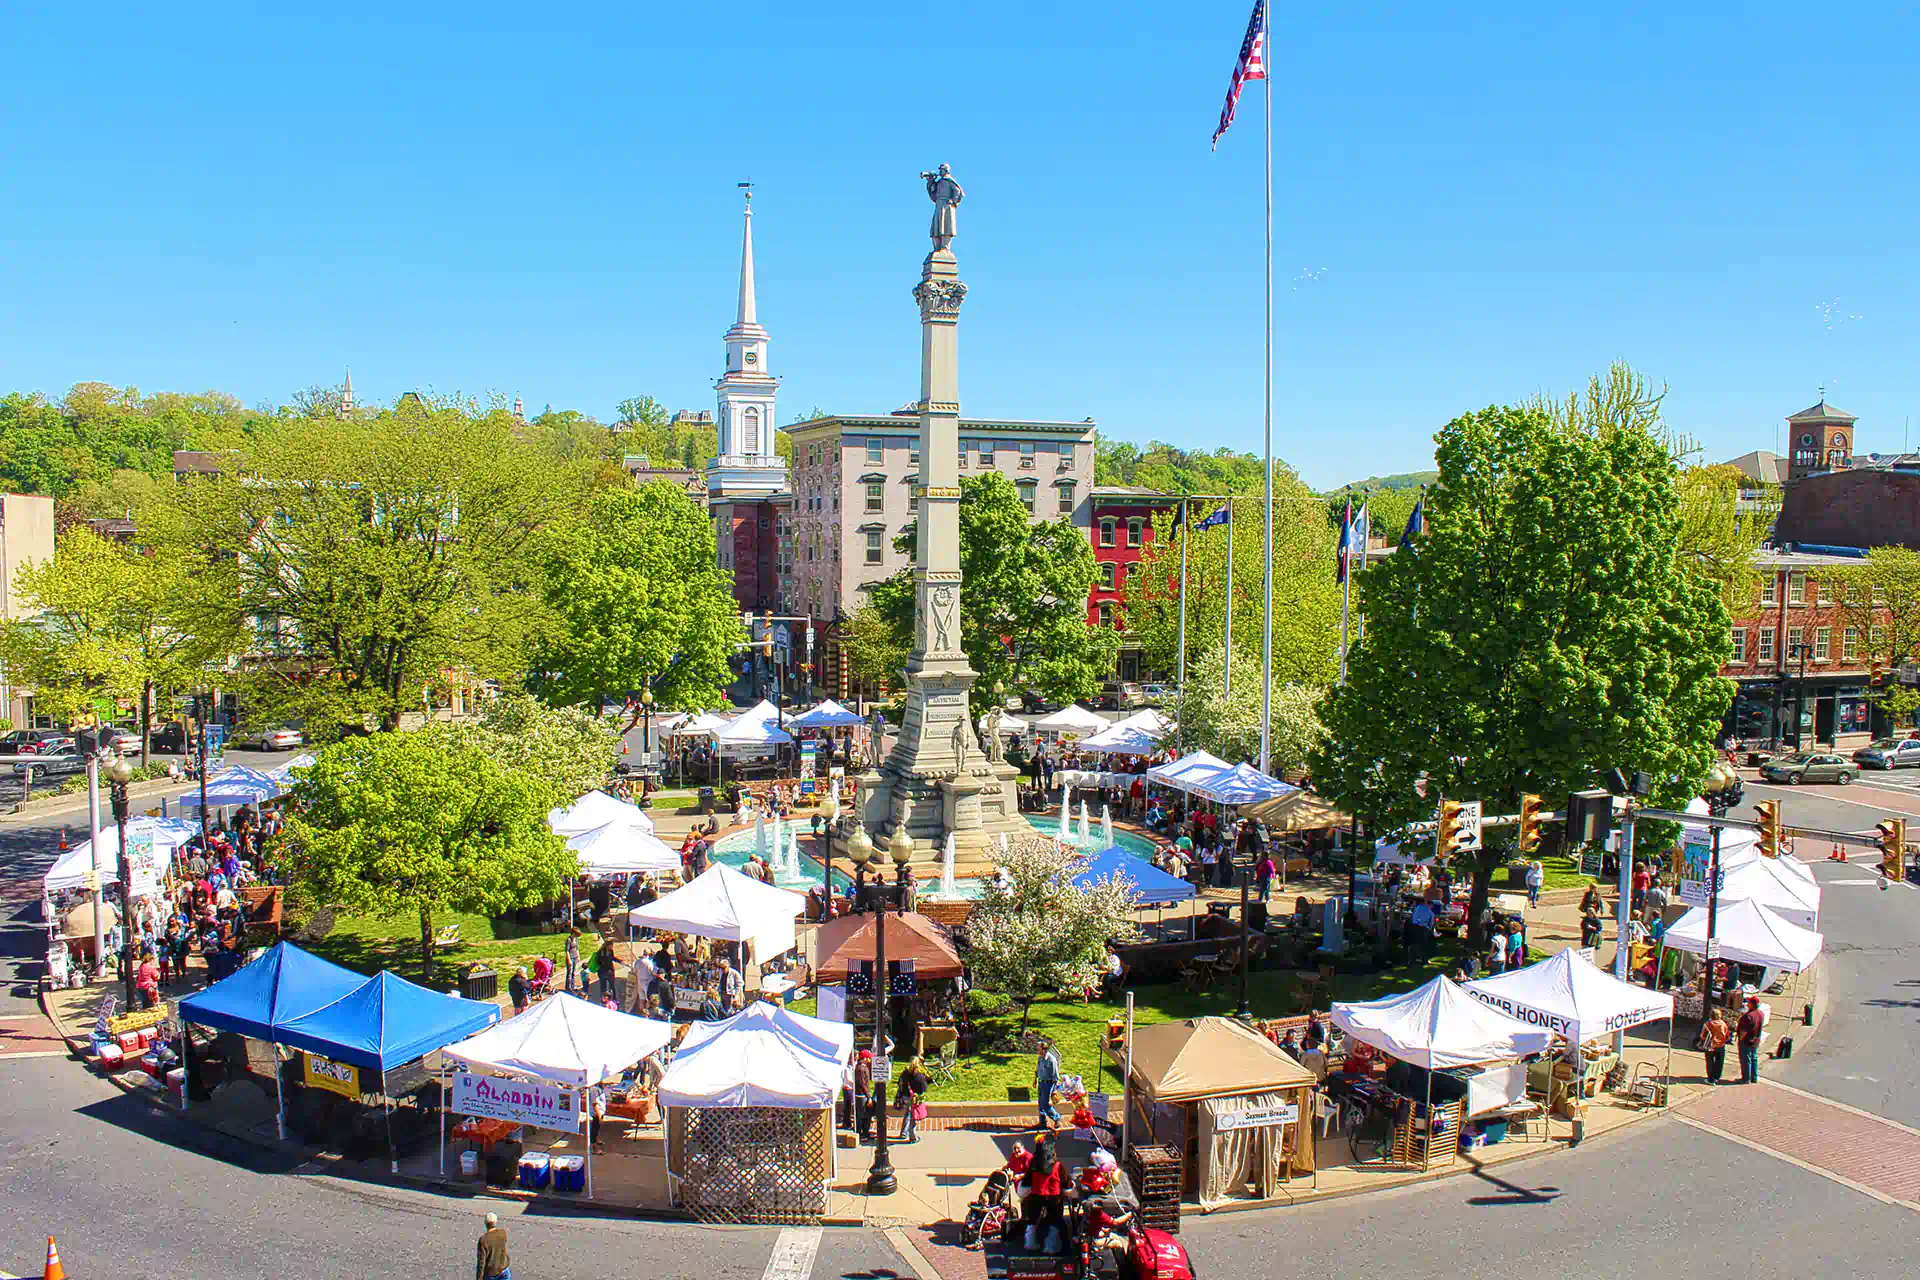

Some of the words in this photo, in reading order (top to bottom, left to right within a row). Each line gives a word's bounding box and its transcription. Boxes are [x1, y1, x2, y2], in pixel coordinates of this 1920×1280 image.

[1459, 806, 1476, 818] ONE
[1458, 819, 1476, 830] WAY
[1516, 1005, 1571, 1034] HONEY
[1605, 1005, 1648, 1031] HONEY
